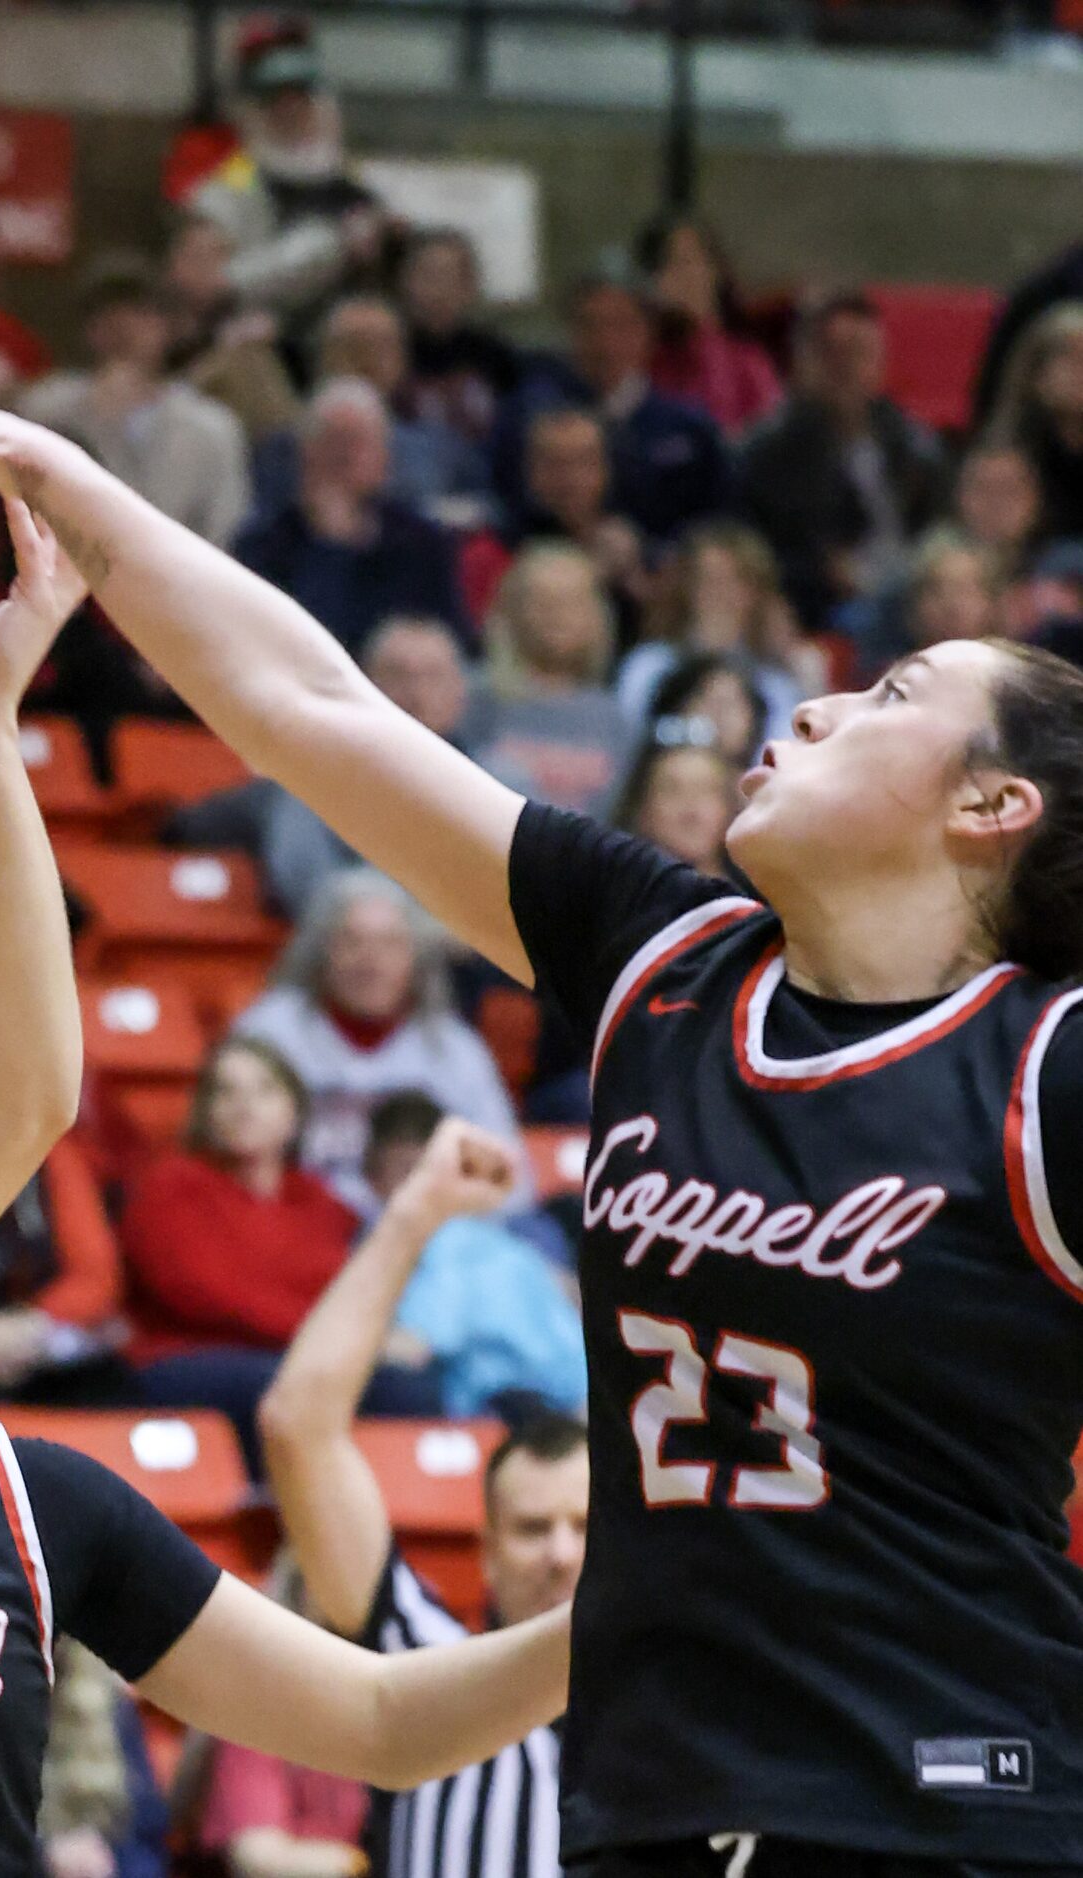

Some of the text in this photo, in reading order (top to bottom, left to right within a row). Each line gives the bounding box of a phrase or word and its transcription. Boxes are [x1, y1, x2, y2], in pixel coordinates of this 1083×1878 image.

[583, 1114, 948, 1290] Coppell
[616, 1307, 831, 1511] 23
[998, 1752, 1020, 1776] M
